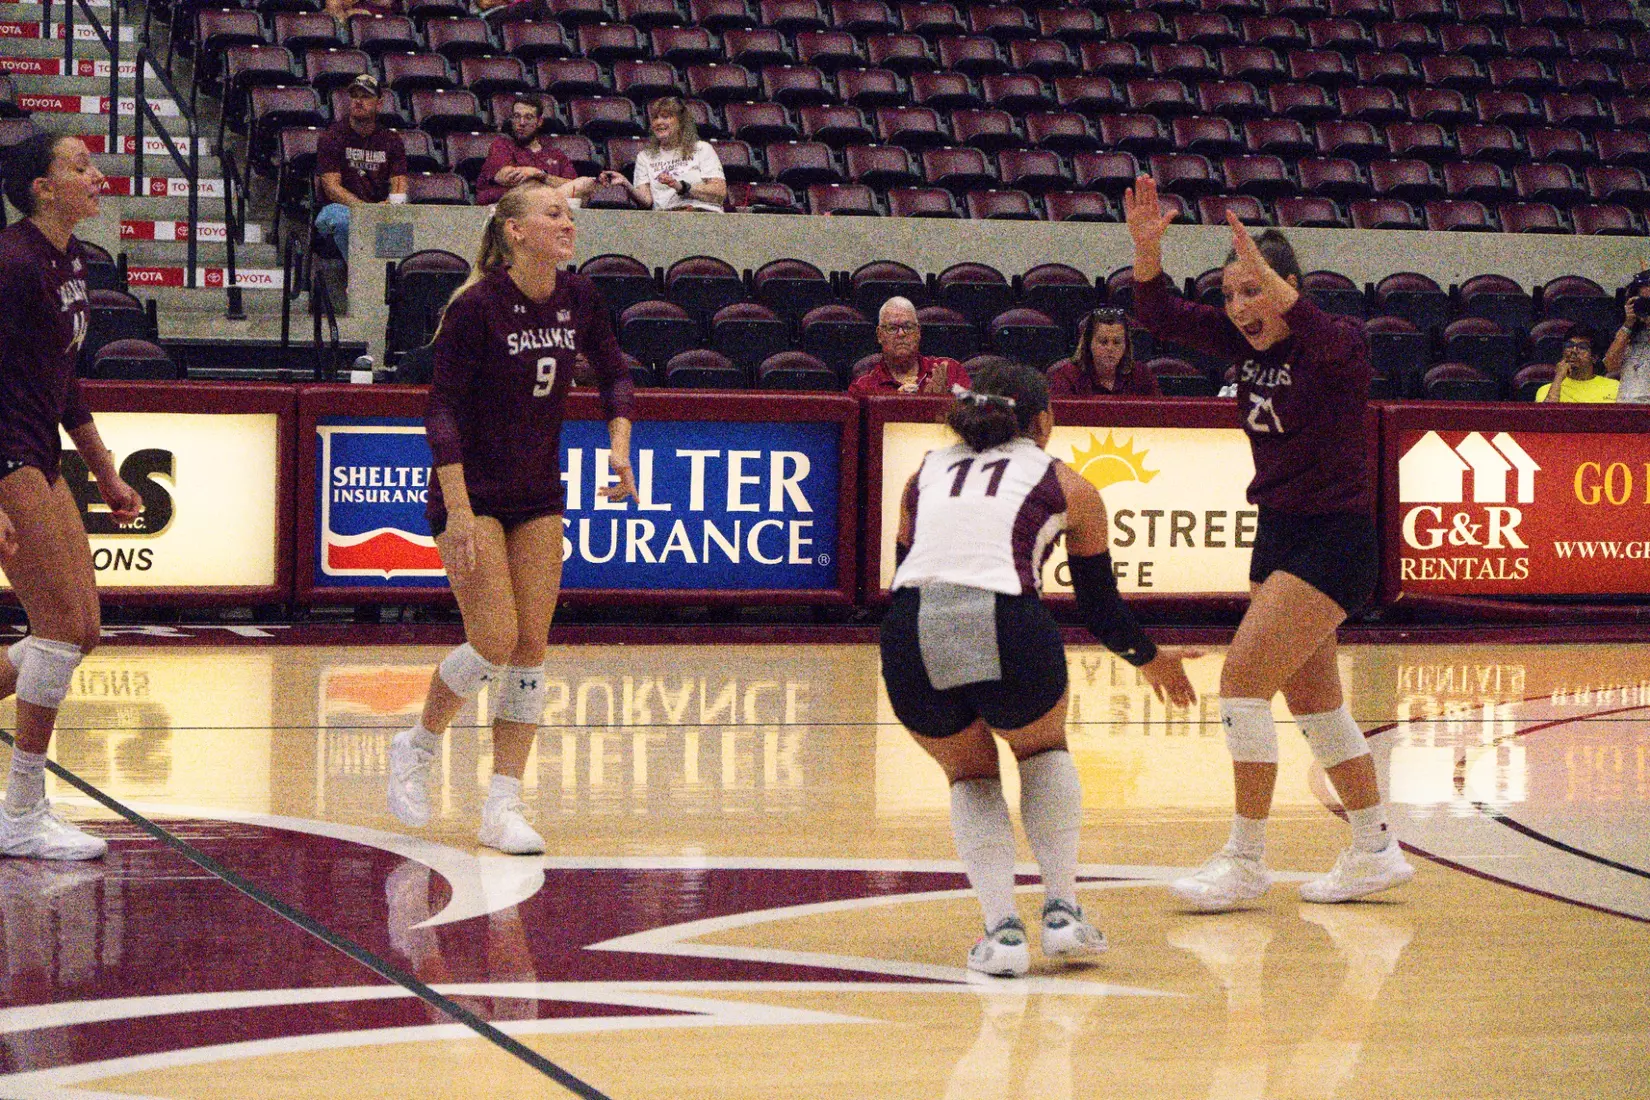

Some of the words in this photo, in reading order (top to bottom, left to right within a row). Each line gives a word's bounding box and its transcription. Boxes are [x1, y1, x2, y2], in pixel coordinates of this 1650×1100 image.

[1, 60, 41, 71] TOYOTA
[98, 64, 137, 73] TOOTA
[21, 98, 62, 108] TOYOTA
[533, 357, 556, 397] 9
[946, 456, 1011, 498] 11
[1573, 461, 1633, 505] GO
[1402, 505, 1529, 550] G&R
[1054, 560, 1154, 587] CFE
[1400, 557, 1529, 580] RENTALS
